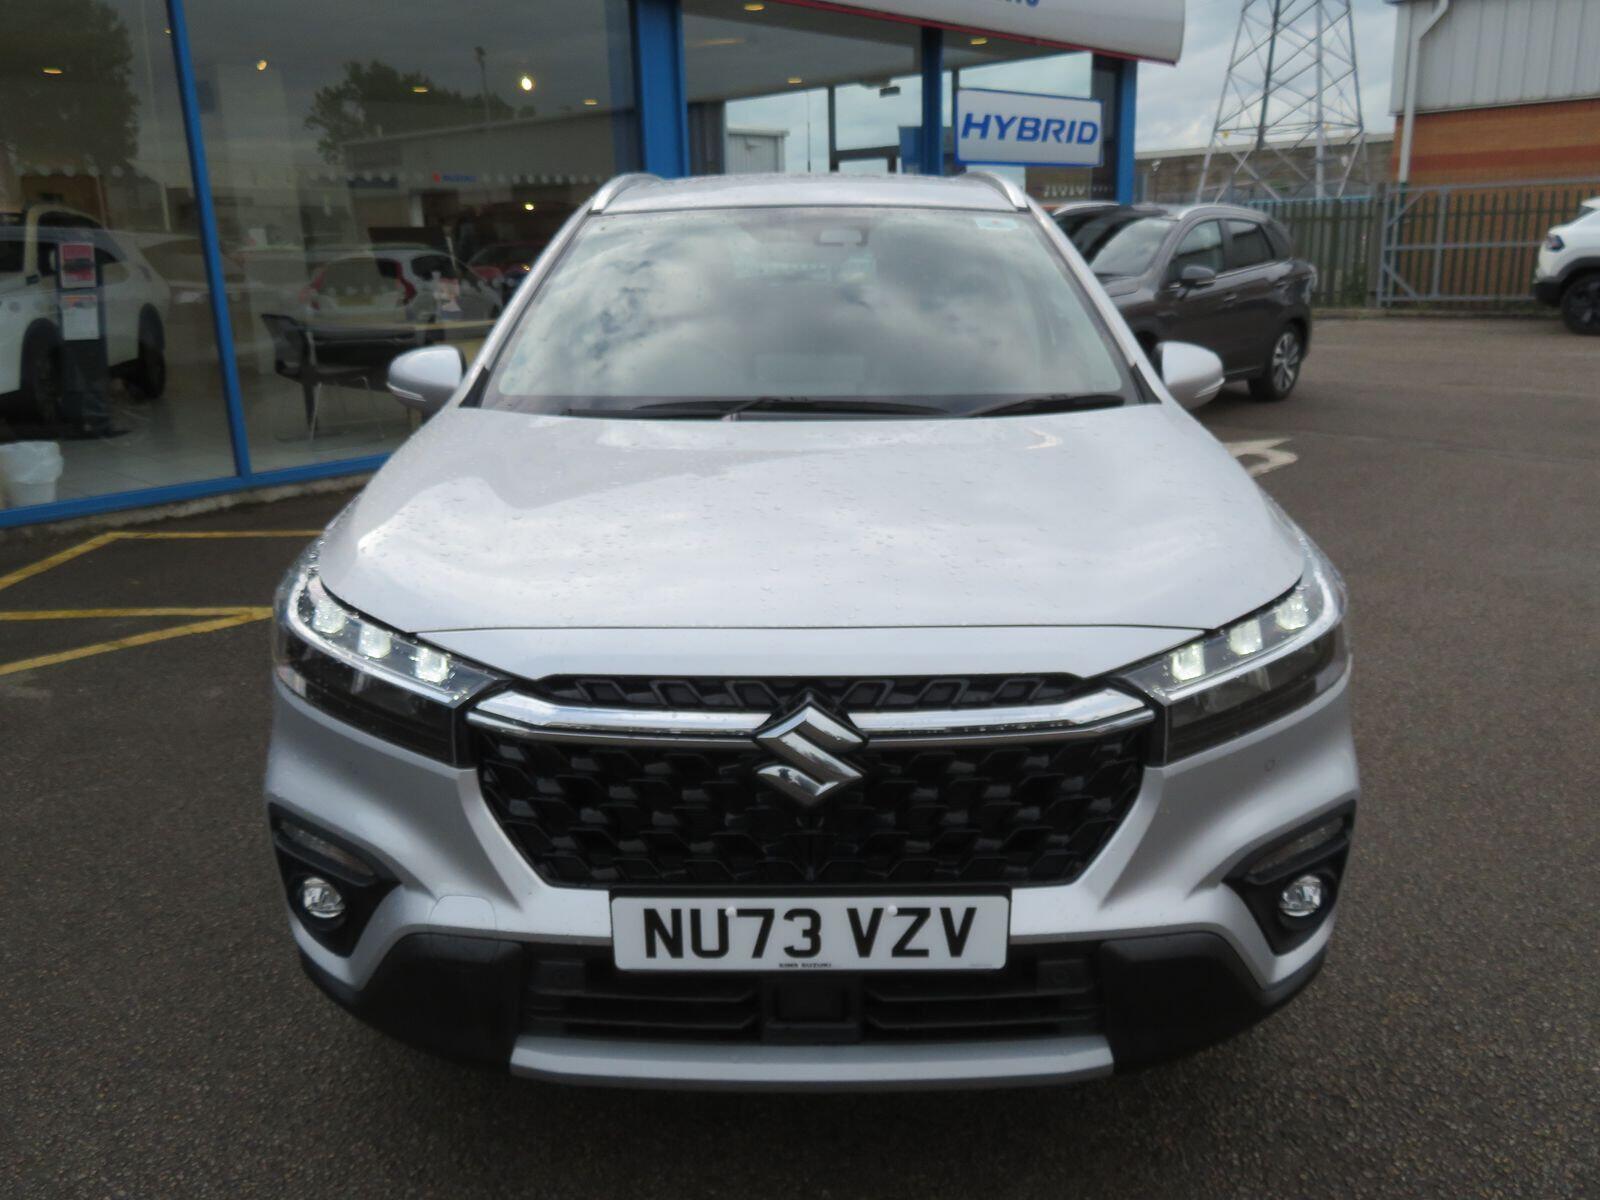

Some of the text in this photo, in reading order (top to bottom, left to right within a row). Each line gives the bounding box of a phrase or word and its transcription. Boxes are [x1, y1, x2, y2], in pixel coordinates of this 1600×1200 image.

[961, 113, 1099, 145] HYBRID
[643, 907, 977, 959] NU73 VZV
